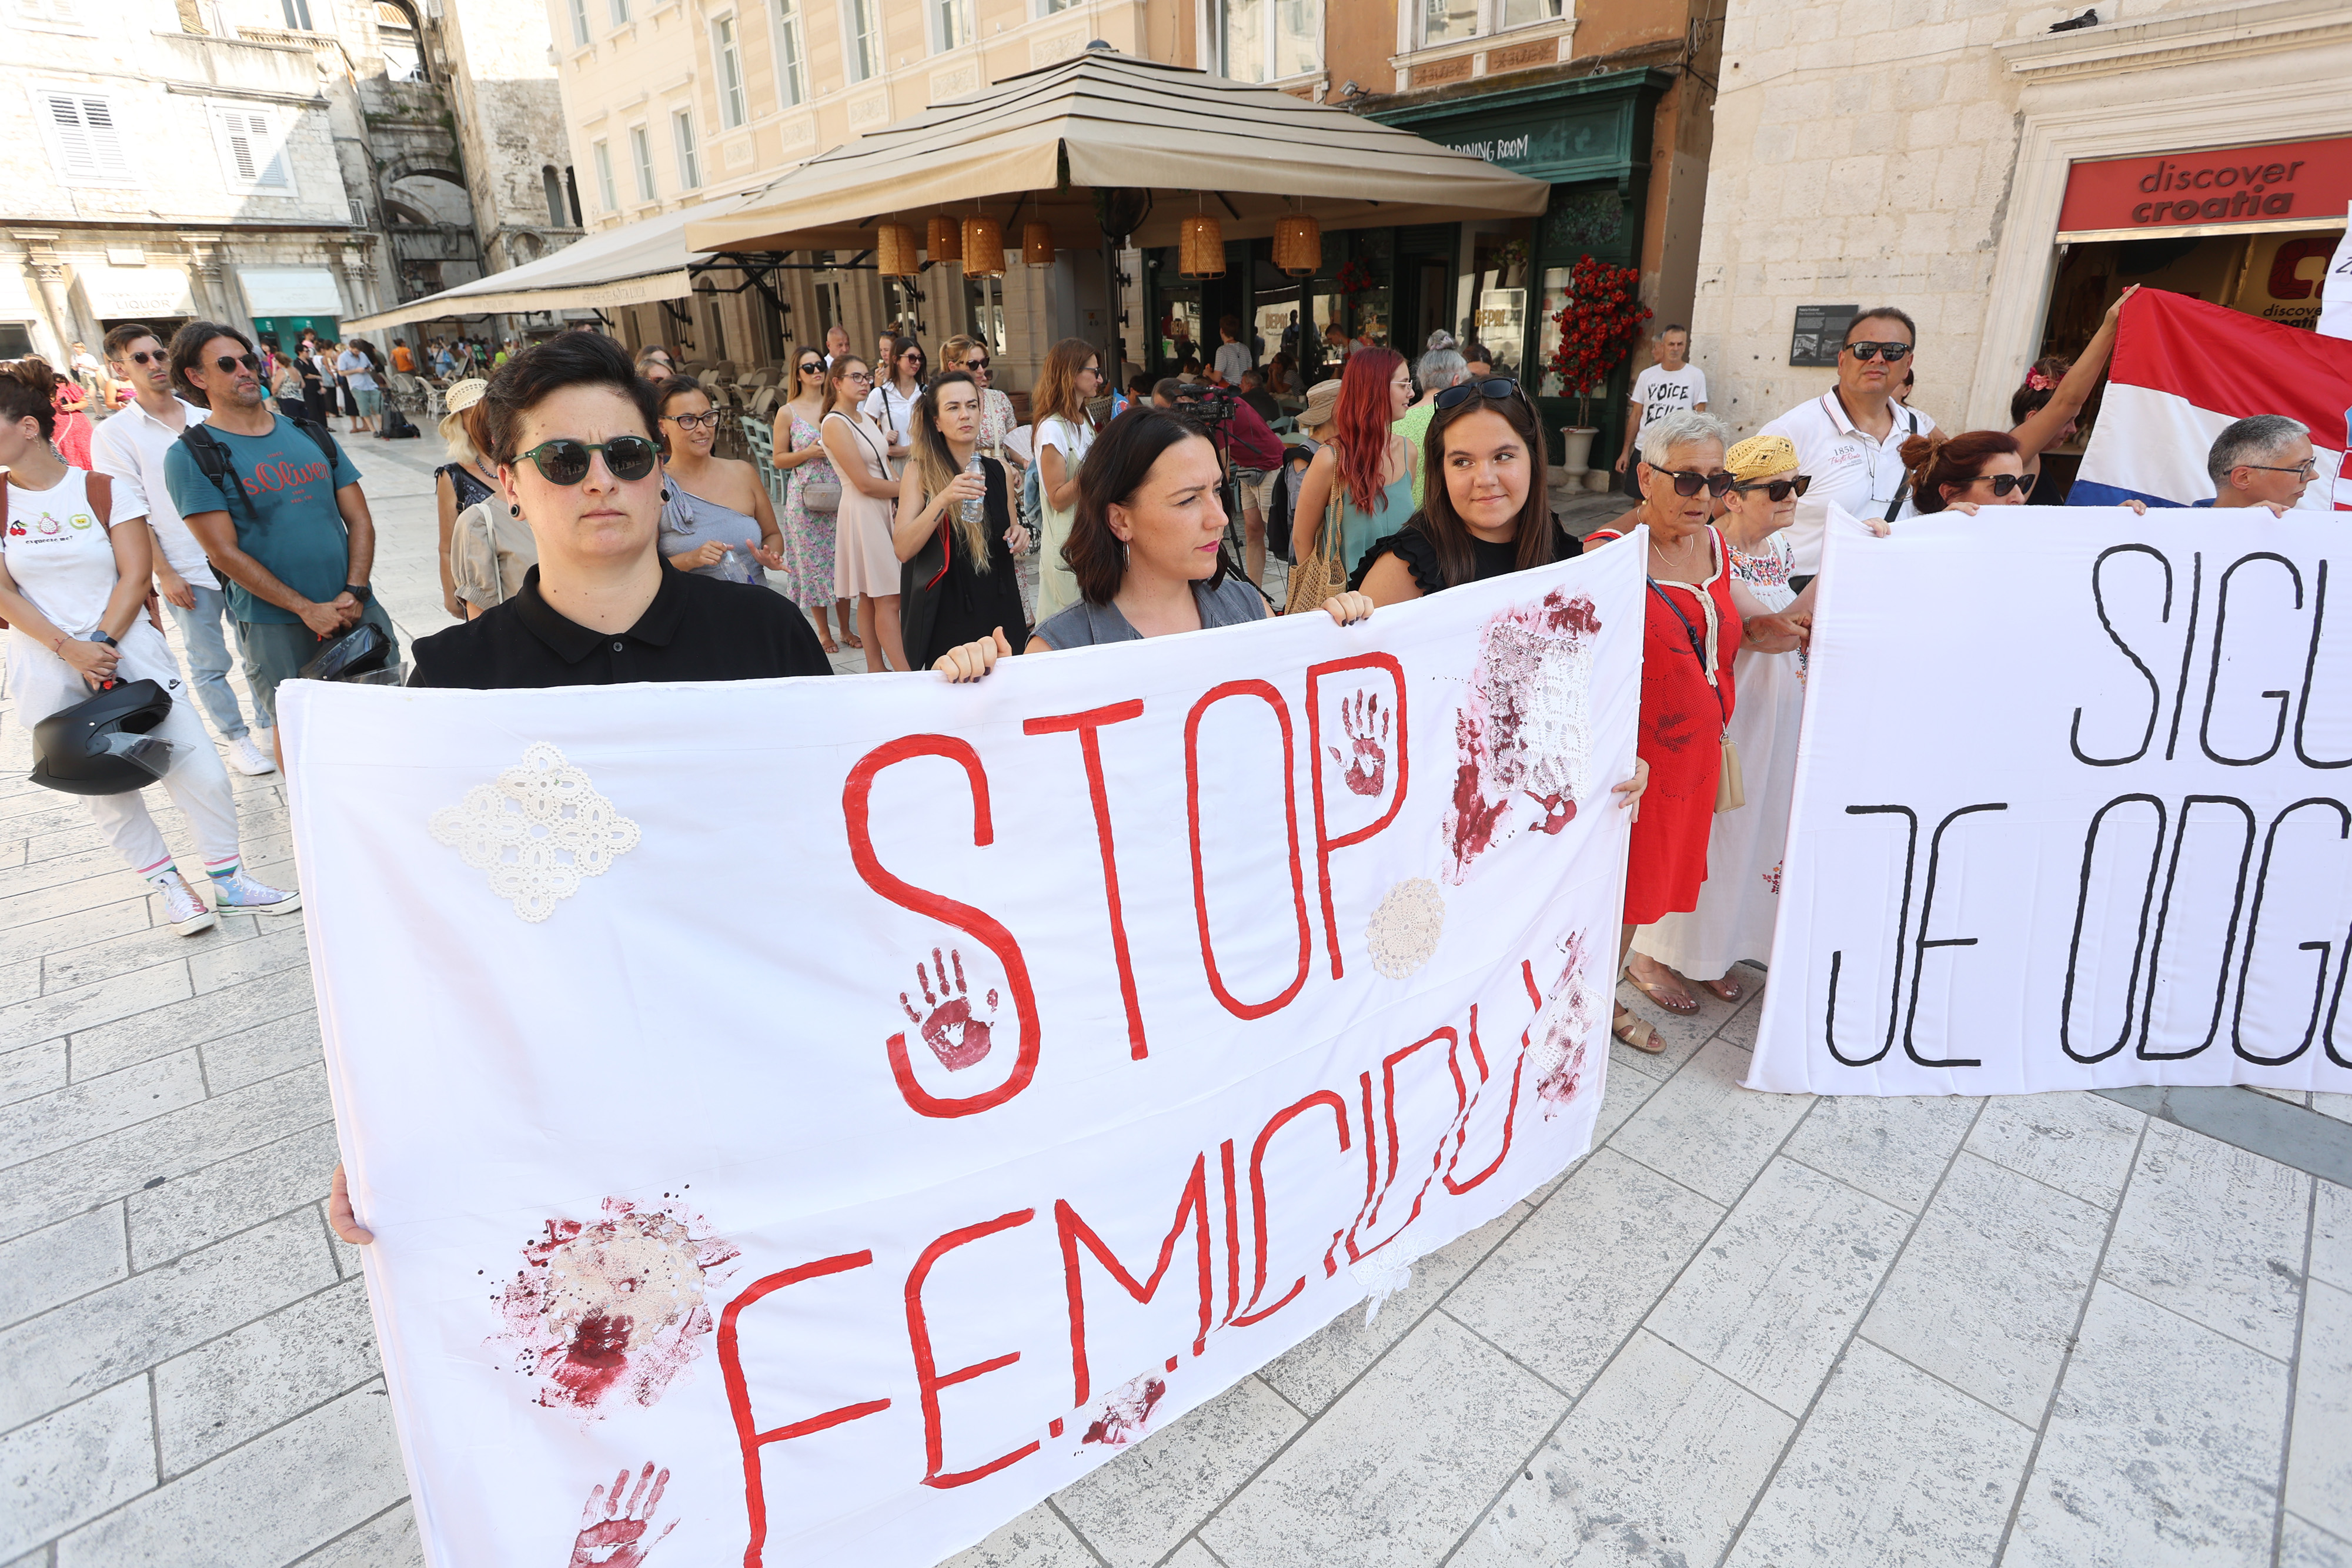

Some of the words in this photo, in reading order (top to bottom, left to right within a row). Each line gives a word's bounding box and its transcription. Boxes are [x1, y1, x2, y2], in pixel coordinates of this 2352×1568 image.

[1497, 134, 1528, 159] ROOM
[2139, 160, 2305, 193] discover
[2132, 184, 2294, 223] croatia
[116, 299, 171, 310] LIQUOR
[2263, 303, 2322, 317] discove
[1834, 445, 1855, 456] 1858
[242, 461, 330, 496] s.Oliver
[841, 651, 1408, 1119] STOP
[1826, 803, 2008, 1069] JE
[2061, 793, 2352, 1068] ODG
